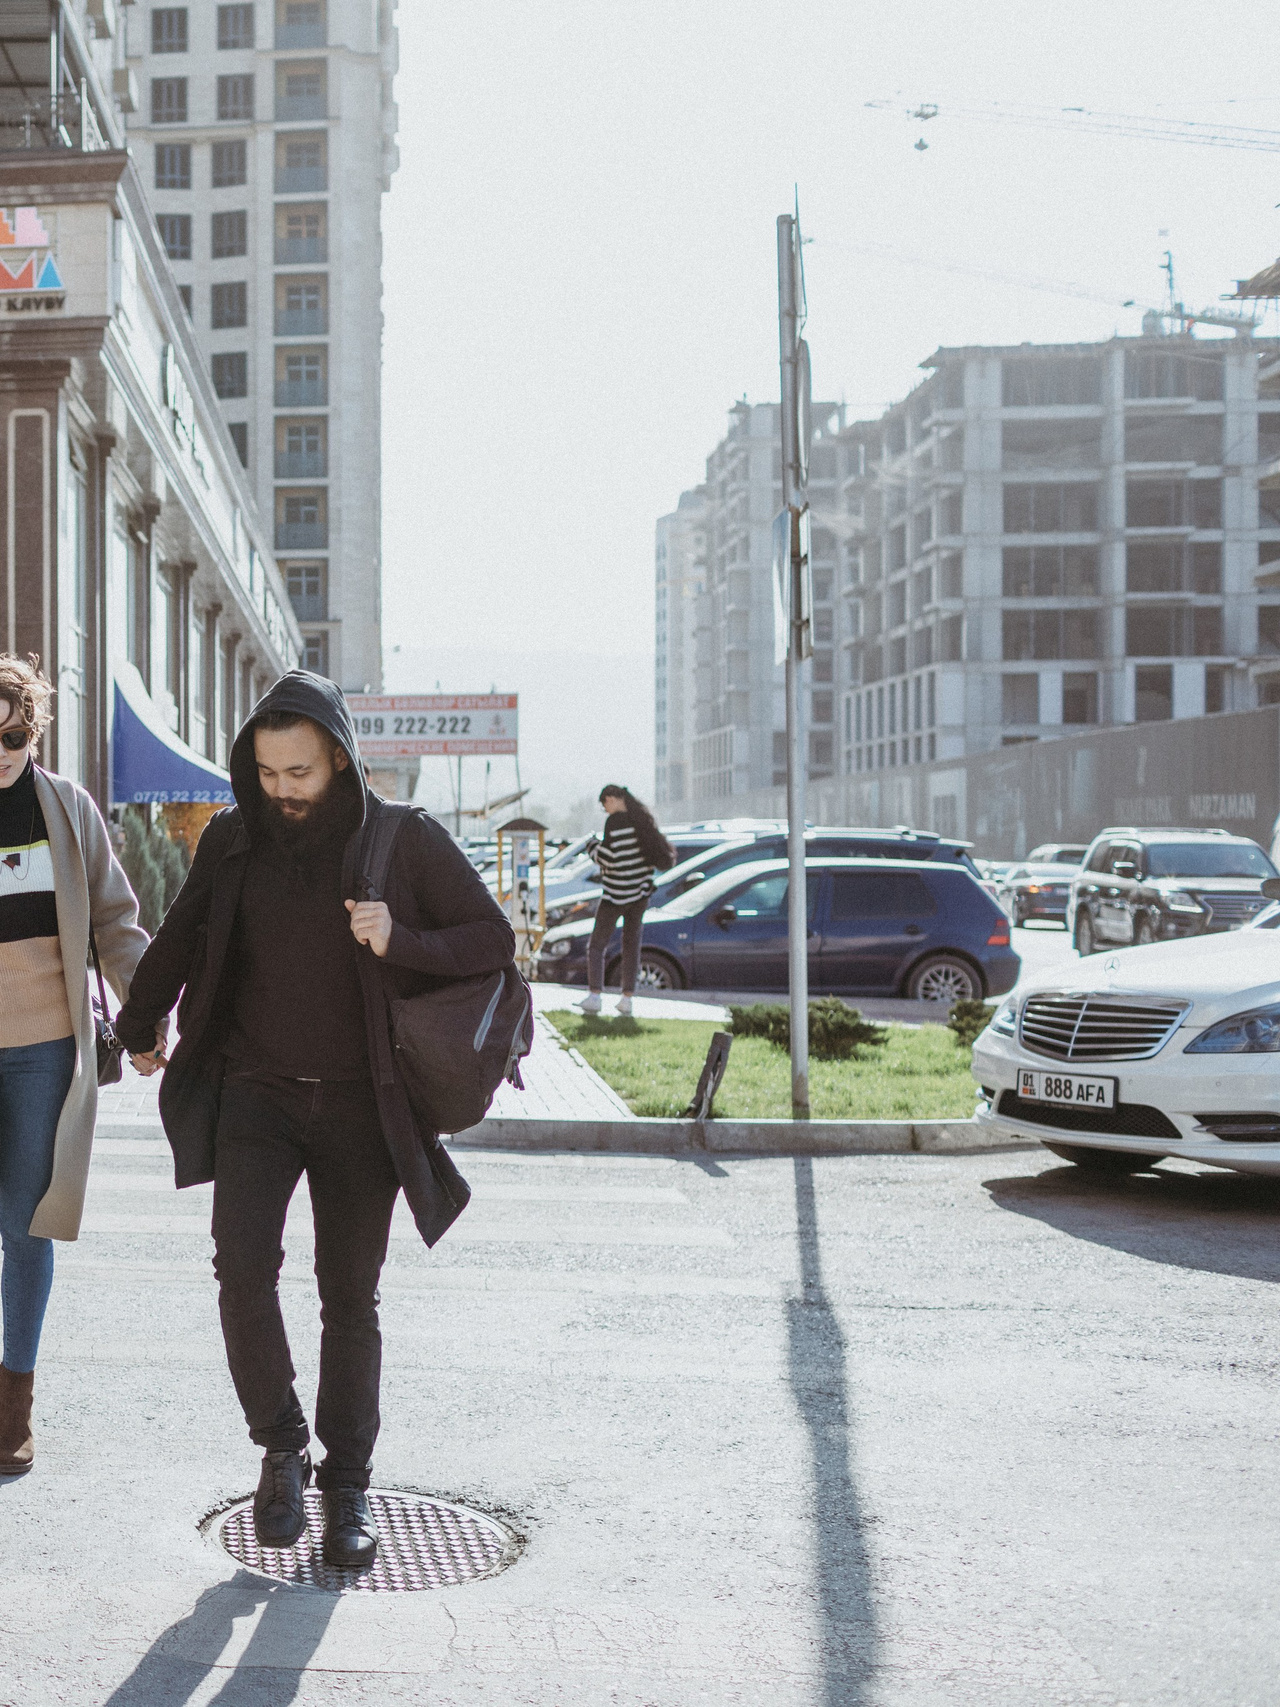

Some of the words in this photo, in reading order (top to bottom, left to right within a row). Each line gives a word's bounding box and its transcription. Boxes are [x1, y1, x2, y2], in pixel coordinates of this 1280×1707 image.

[394, 715, 471, 735] 222-222
[133, 790, 168, 803] 0775
[171, 790, 190, 803] 22
[193, 790, 211, 803] 22
[214, 790, 232, 803] 22
[1023, 1073, 1034, 1087] 01
[1044, 1077, 1073, 1099] 888
[1076, 1084, 1105, 1103] AFA
